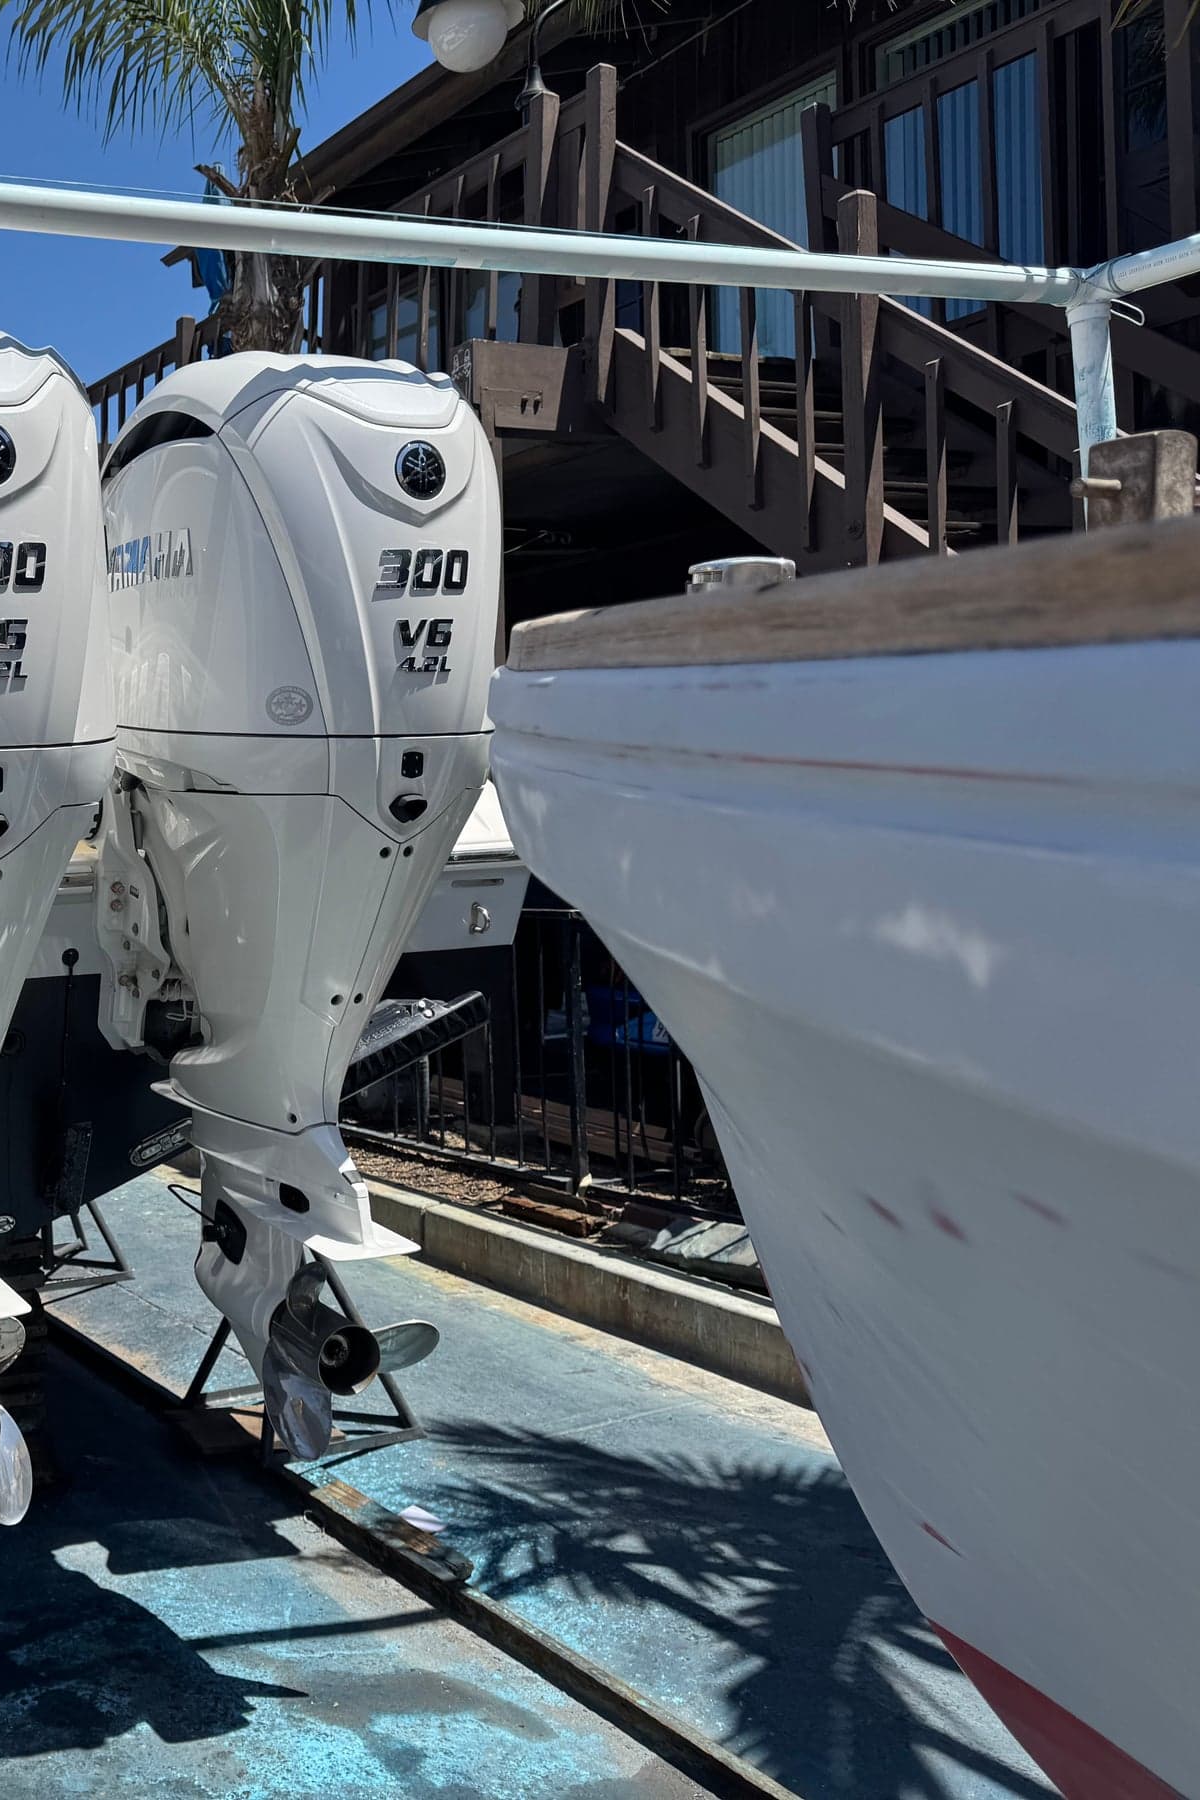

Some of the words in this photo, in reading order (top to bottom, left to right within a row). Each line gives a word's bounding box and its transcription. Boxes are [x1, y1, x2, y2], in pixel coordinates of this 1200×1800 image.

[377, 548, 469, 588] 300
[395, 618, 454, 648] V6
[399, 655, 452, 673] 4.2L
